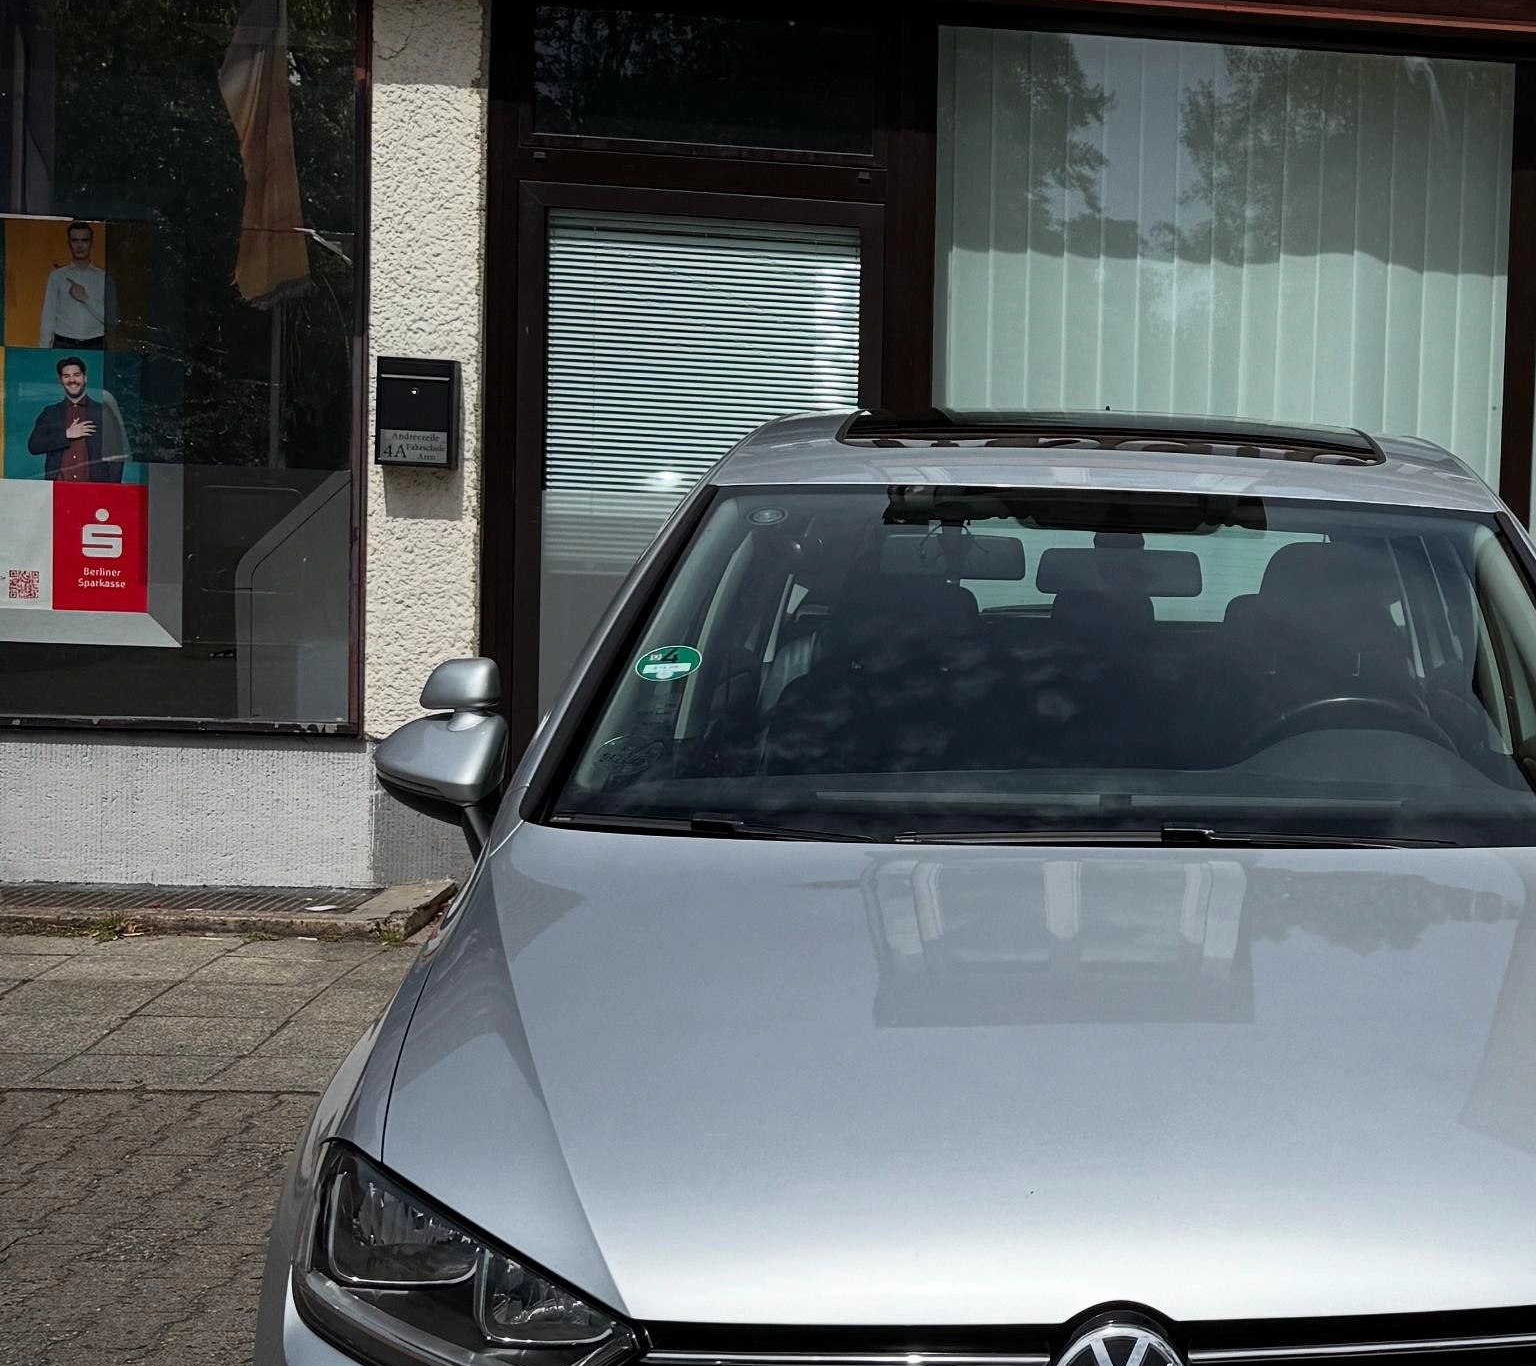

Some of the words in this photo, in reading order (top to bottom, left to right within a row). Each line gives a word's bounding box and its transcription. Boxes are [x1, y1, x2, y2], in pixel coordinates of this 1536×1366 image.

[384, 443, 406, 458] 4A
[83, 567, 122, 577] Berliner
[78, 578, 126, 589] Sparkasse
